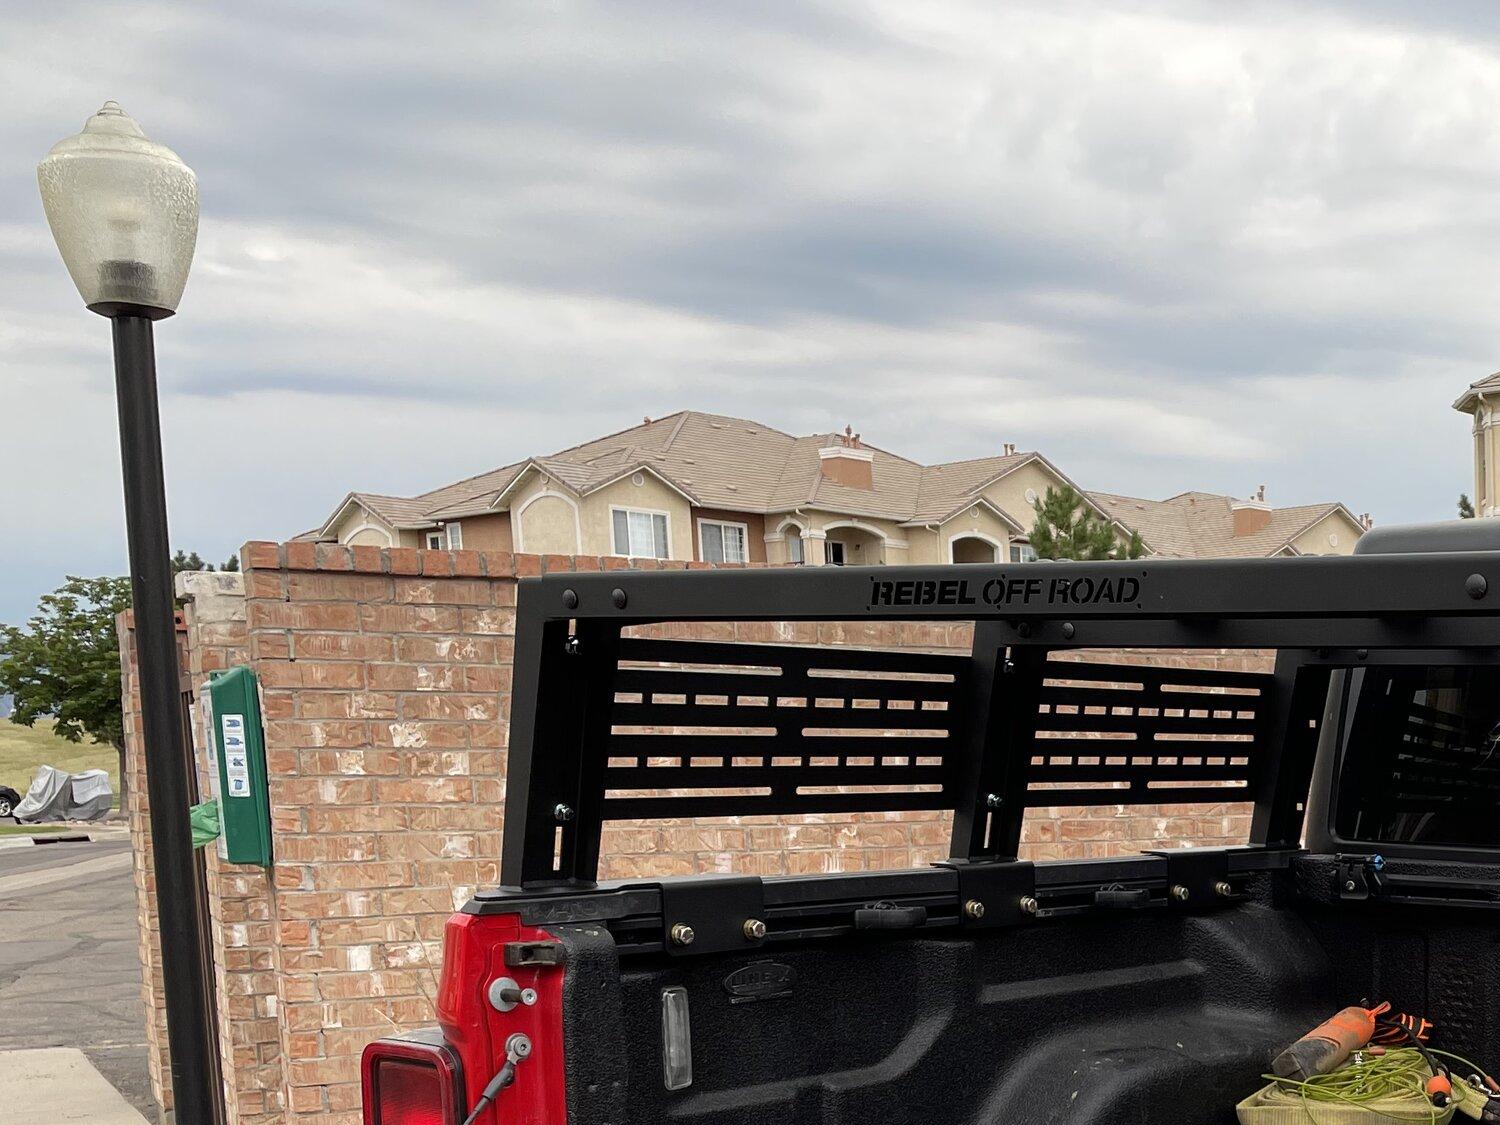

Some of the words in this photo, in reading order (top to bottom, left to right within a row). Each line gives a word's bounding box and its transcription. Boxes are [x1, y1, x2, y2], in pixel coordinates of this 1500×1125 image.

[871, 580, 976, 606] REBEL
[982, 578, 1043, 605] OFF
[1048, 577, 1140, 604] ROAD
